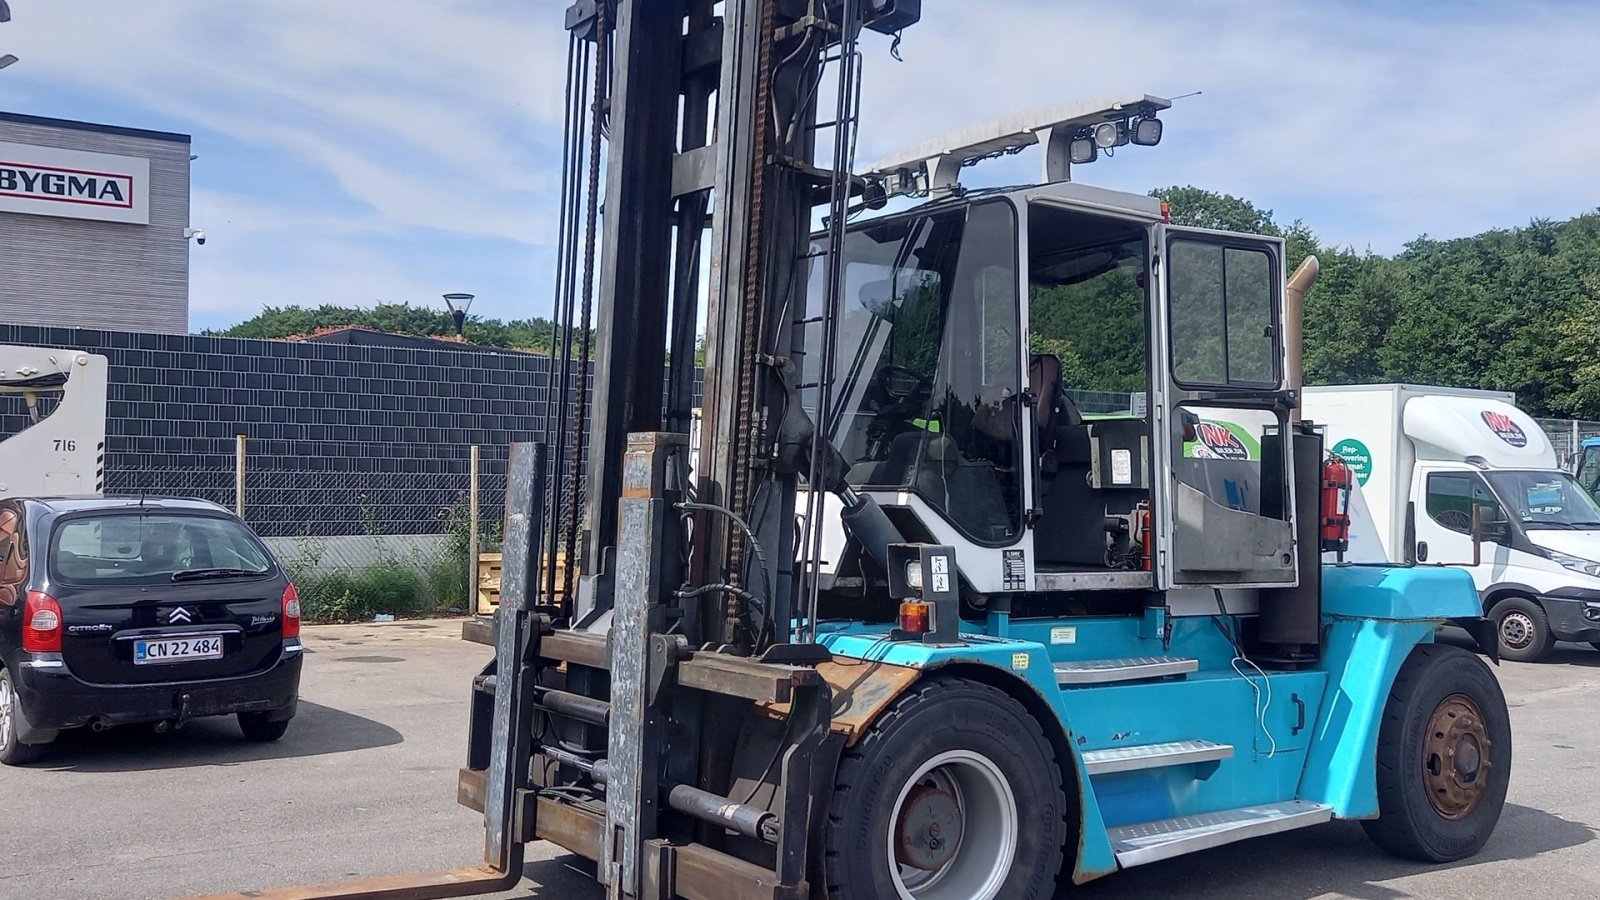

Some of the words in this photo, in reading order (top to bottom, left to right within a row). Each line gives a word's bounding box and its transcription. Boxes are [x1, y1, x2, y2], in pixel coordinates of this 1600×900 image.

[0, 168, 124, 202] BYGMA
[1482, 411, 1520, 434] NK
[53, 439, 76, 451] 716
[1200, 424, 1240, 448] NK
[1342, 445, 1359, 454] Rep-
[147, 642, 167, 657] CN
[171, 641, 189, 656] 22
[193, 639, 219, 654] 484
